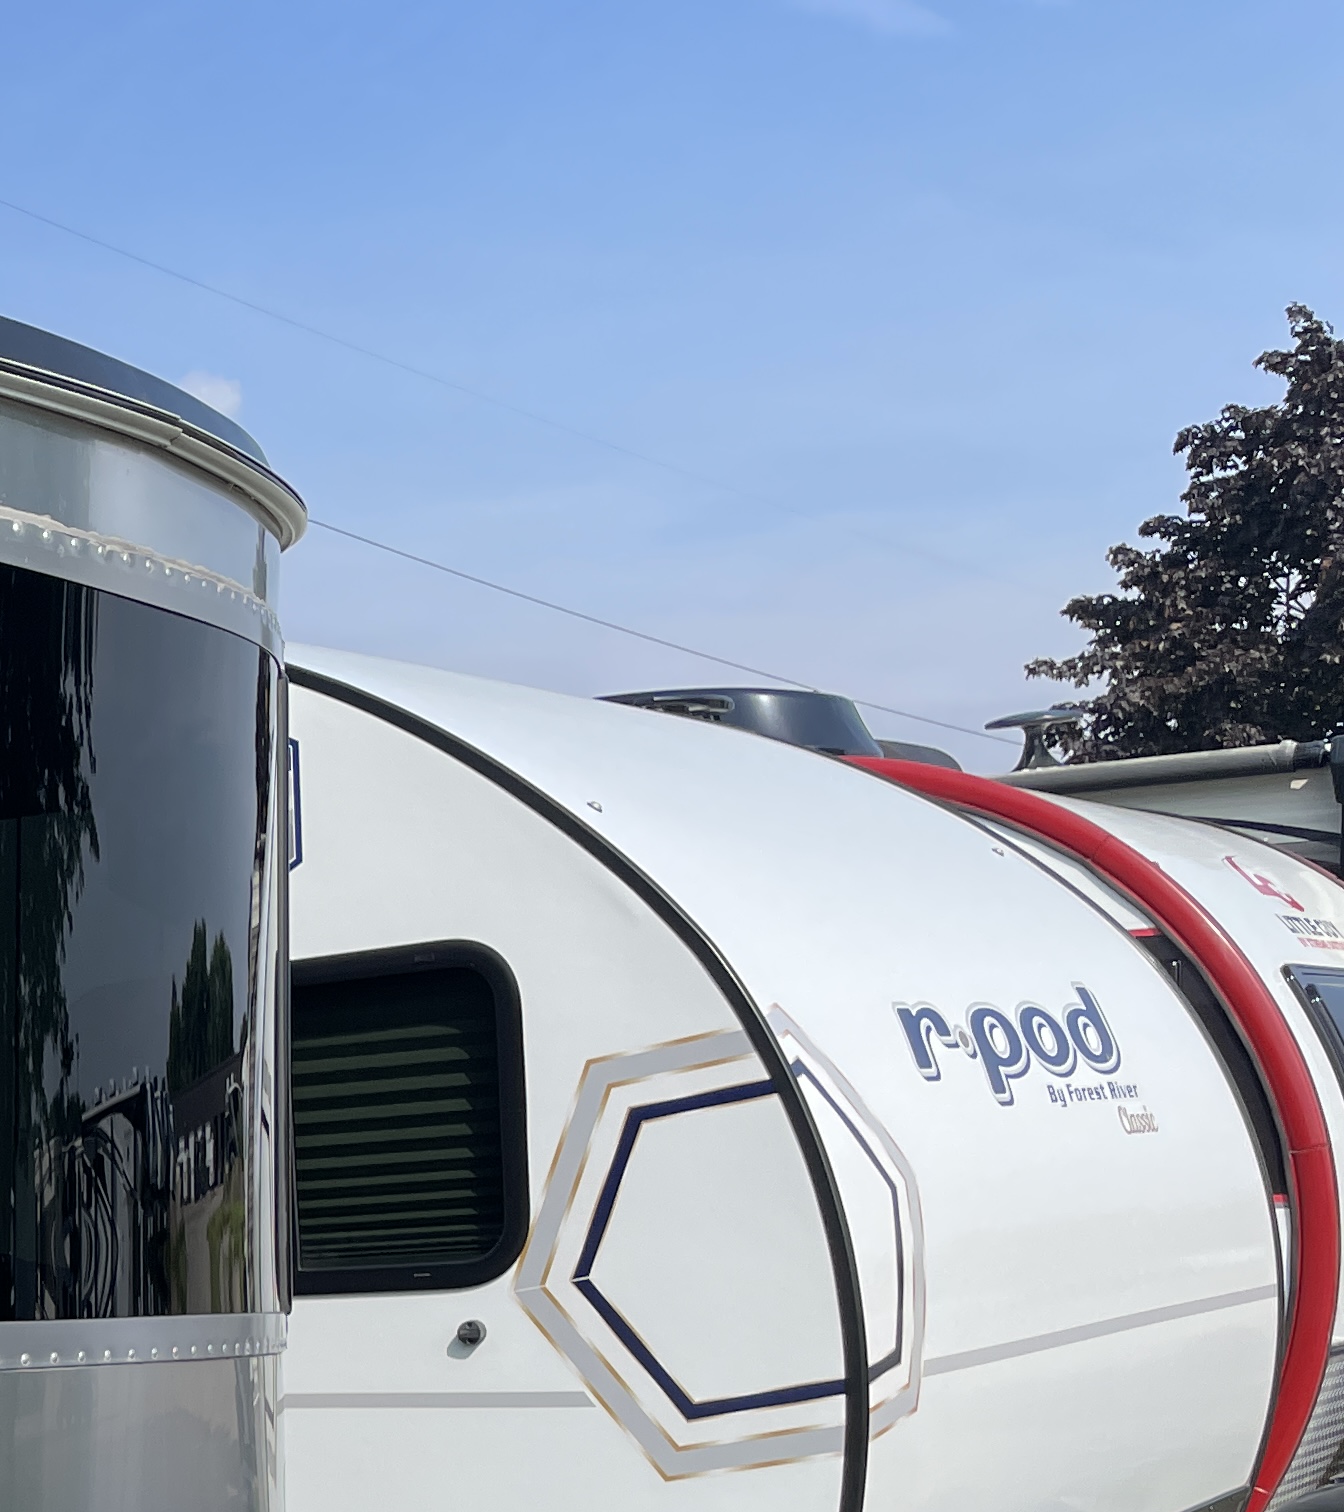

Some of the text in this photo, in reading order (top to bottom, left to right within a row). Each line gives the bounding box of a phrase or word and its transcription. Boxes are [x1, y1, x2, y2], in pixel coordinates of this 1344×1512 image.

[1048, 1081, 1139, 1107] By Forest River
[1118, 1105, 1160, 1135] Classic
